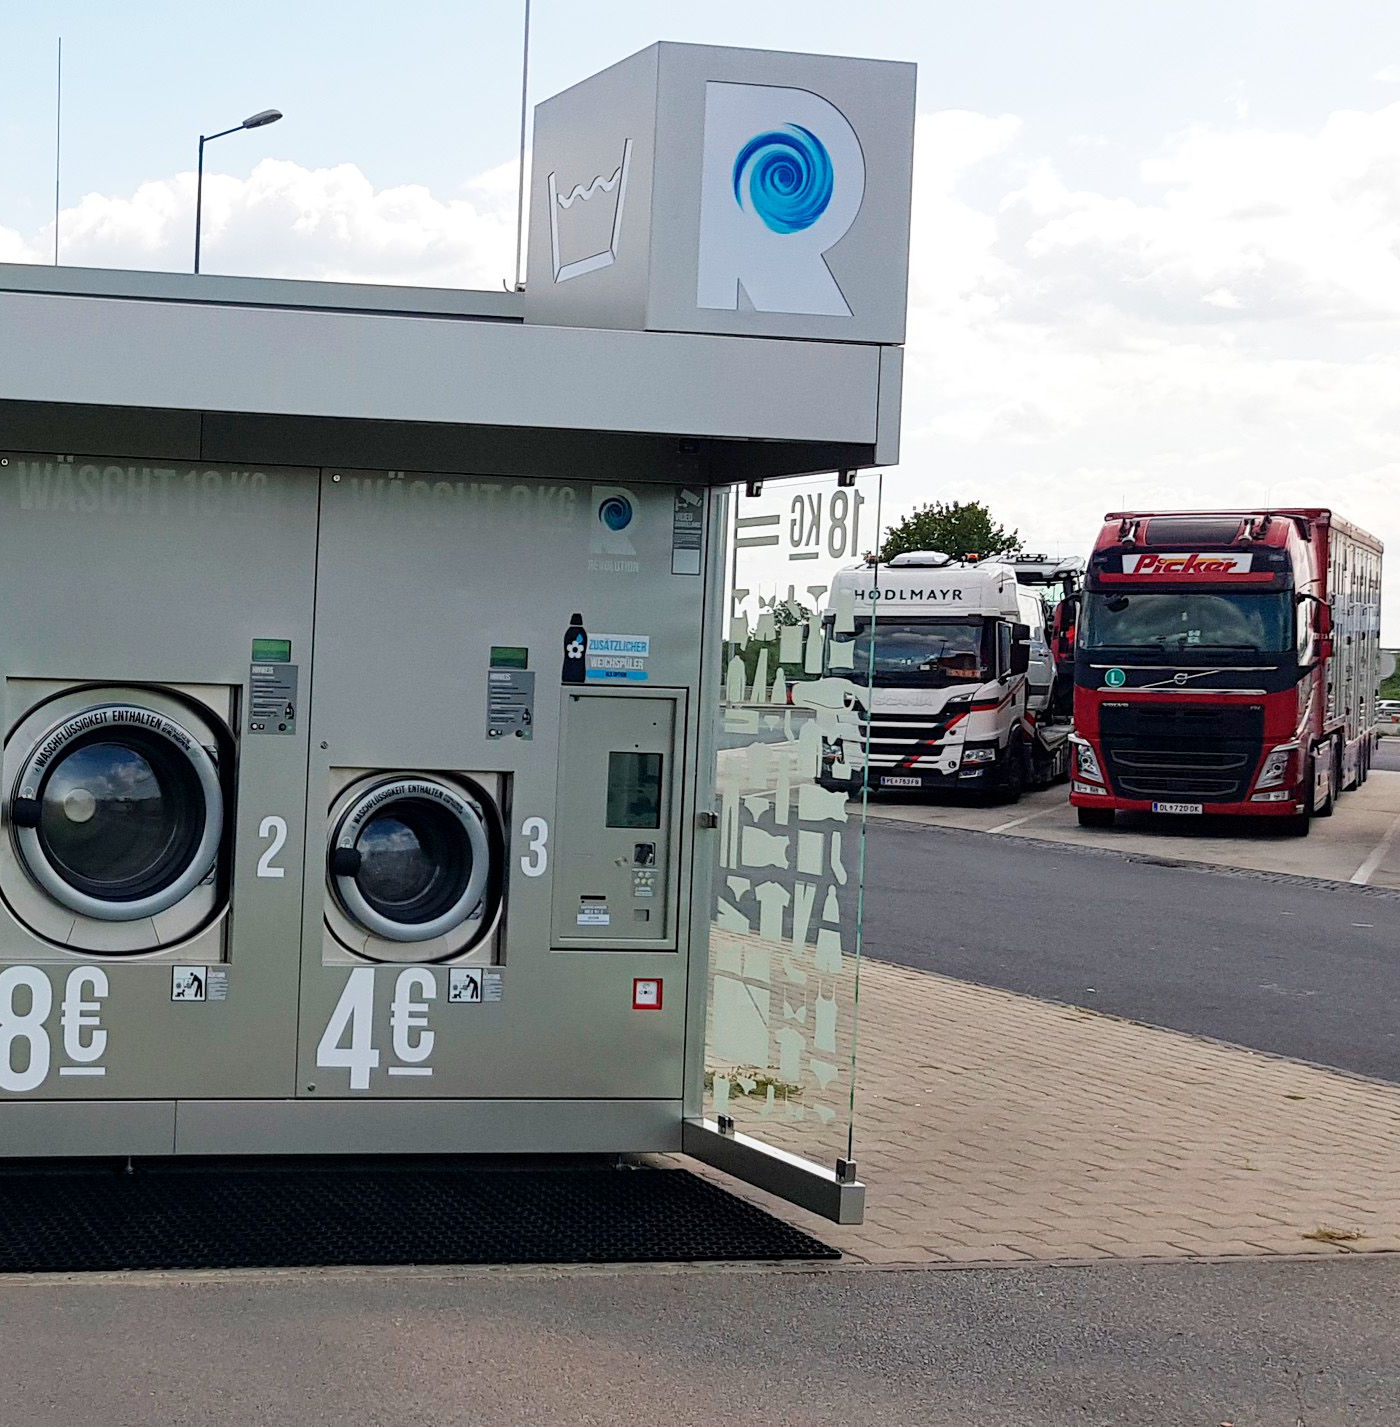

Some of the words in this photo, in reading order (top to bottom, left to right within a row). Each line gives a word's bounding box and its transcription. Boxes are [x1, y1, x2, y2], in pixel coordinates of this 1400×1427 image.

[697, 80, 866, 316] R
[18, 455, 176, 516] WÄSCHT
[1133, 553, 1238, 574] Picker
[35, 711, 108, 768] WASCHFLÜSSIGKEIT
[112, 710, 163, 729] ENTHALTEN
[353, 785, 405, 825] WASCHFLÜSSIGKEIT
[408, 785, 443, 799] ENTHALTEN
[257, 816, 287, 877] 2
[521, 817, 548, 876] 3
